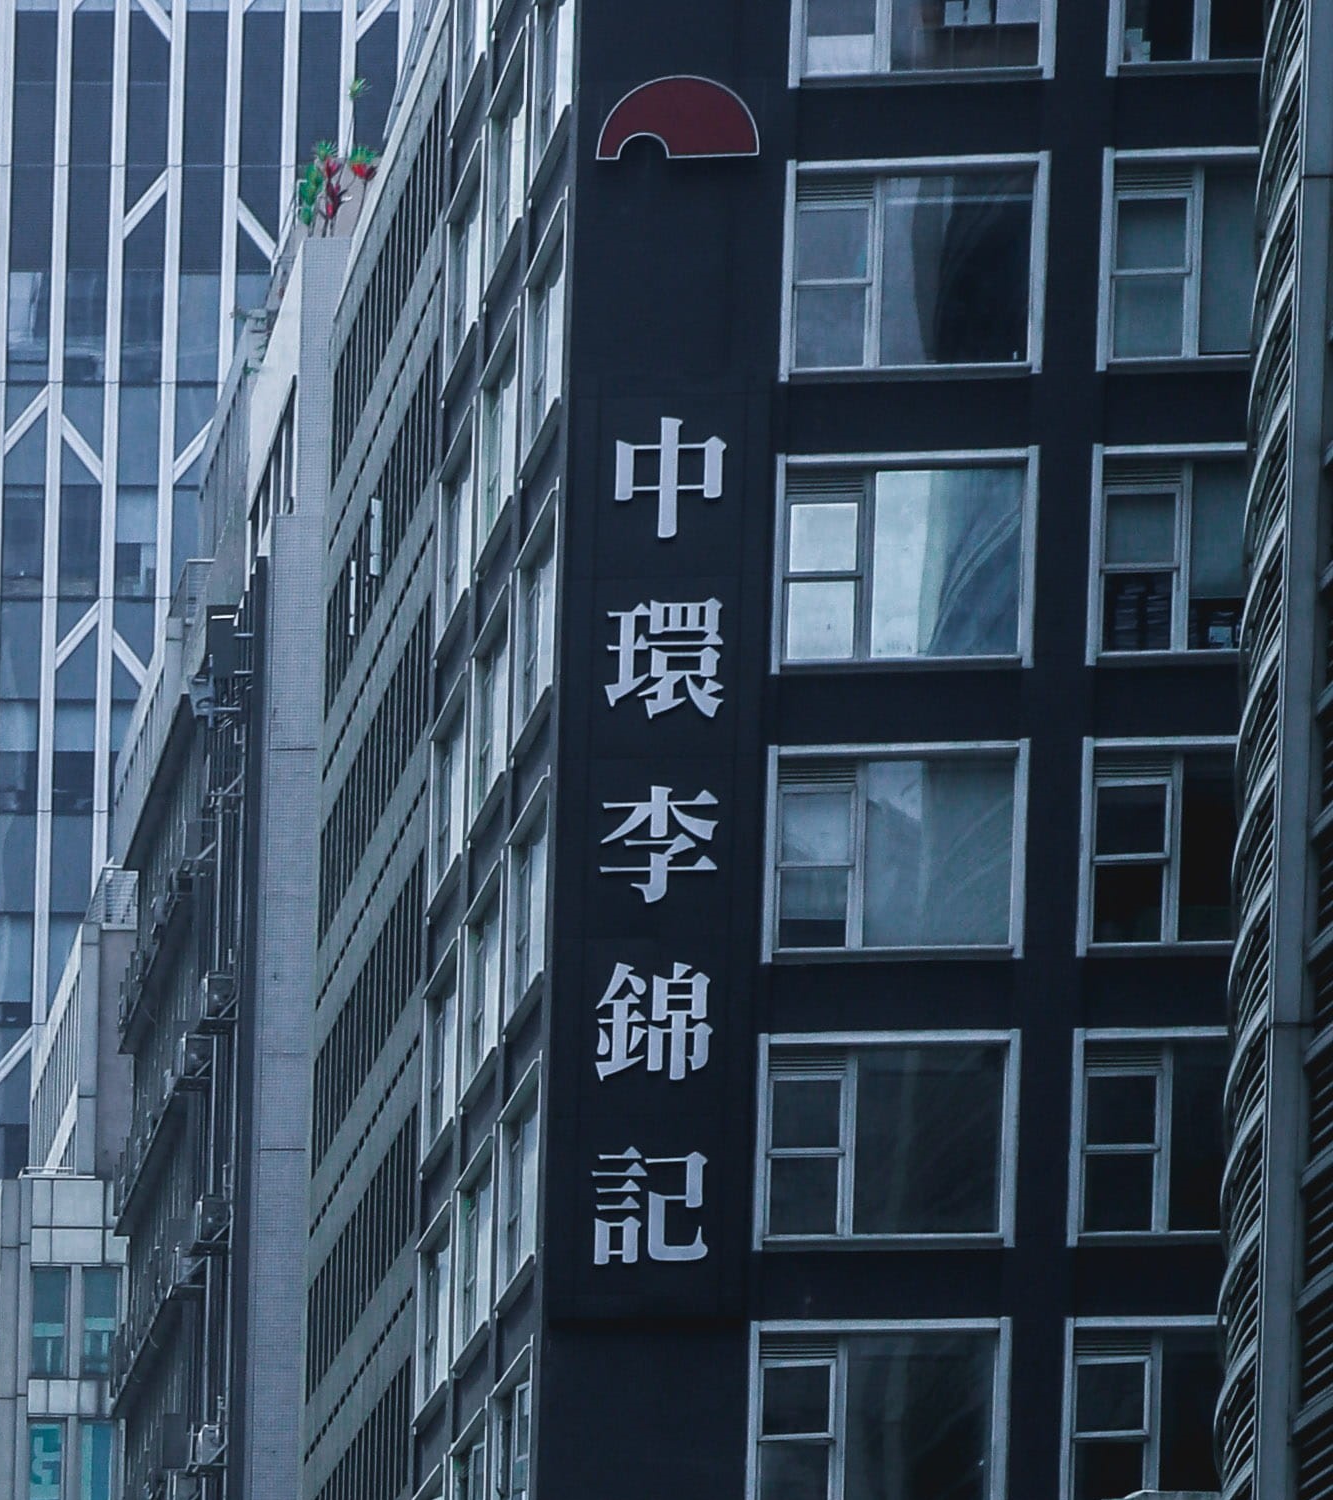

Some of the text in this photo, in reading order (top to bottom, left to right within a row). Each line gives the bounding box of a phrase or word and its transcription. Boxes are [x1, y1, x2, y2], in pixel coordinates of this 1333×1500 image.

[591, 415, 728, 1267] 中環李錦記
